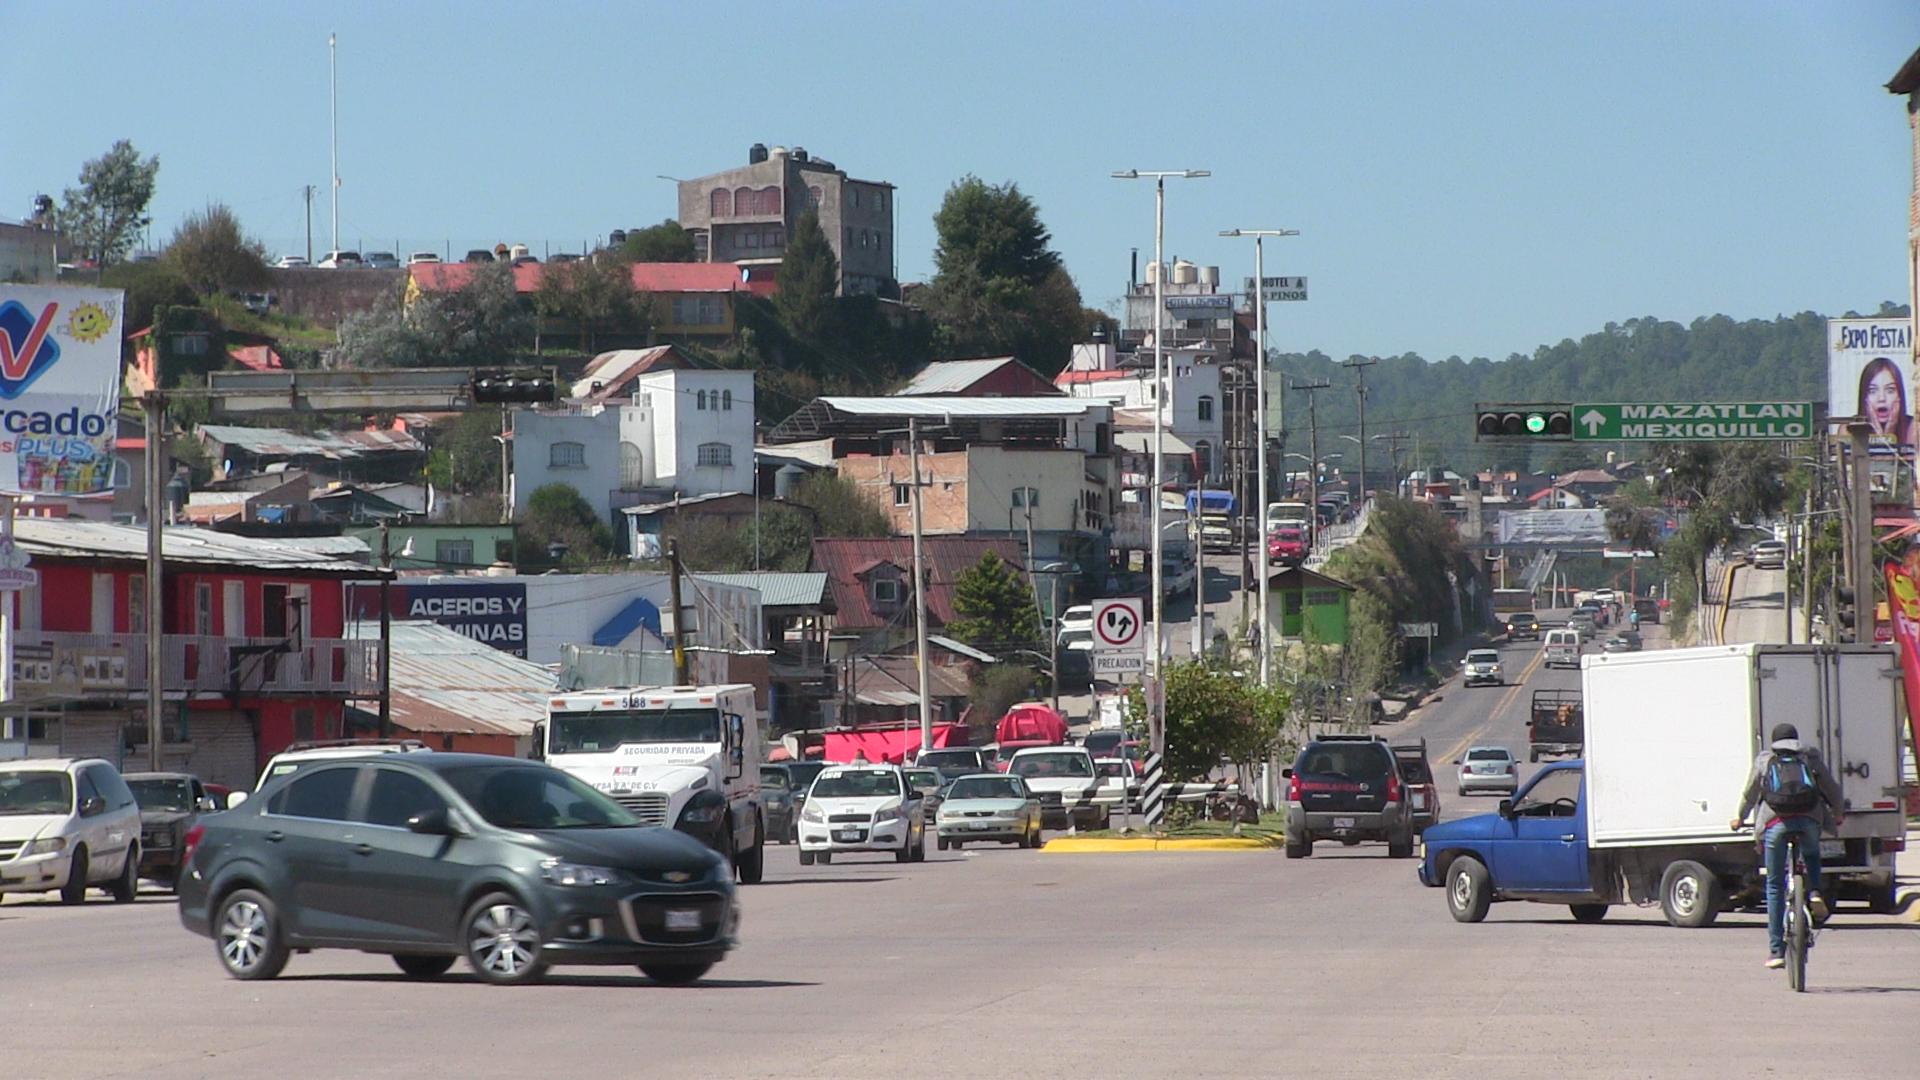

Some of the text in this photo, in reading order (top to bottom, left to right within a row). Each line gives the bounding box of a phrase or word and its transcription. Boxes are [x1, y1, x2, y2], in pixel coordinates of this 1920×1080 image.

[1263, 278, 1288, 288] HOTEL
[1246, 291, 1306, 300] LS PINOS
[1621, 405, 1804, 419] MAZATLAN
[0, 407, 105, 437] cado
[1621, 423, 1804, 437] MEXIQUILLO
[17, 438, 87, 456] PLUS
[409, 597, 523, 616] ACEROS Y
[1097, 658, 1141, 668] PRECAUCION
[624, 746, 706, 756] SEGURIDAD PRIVADA
